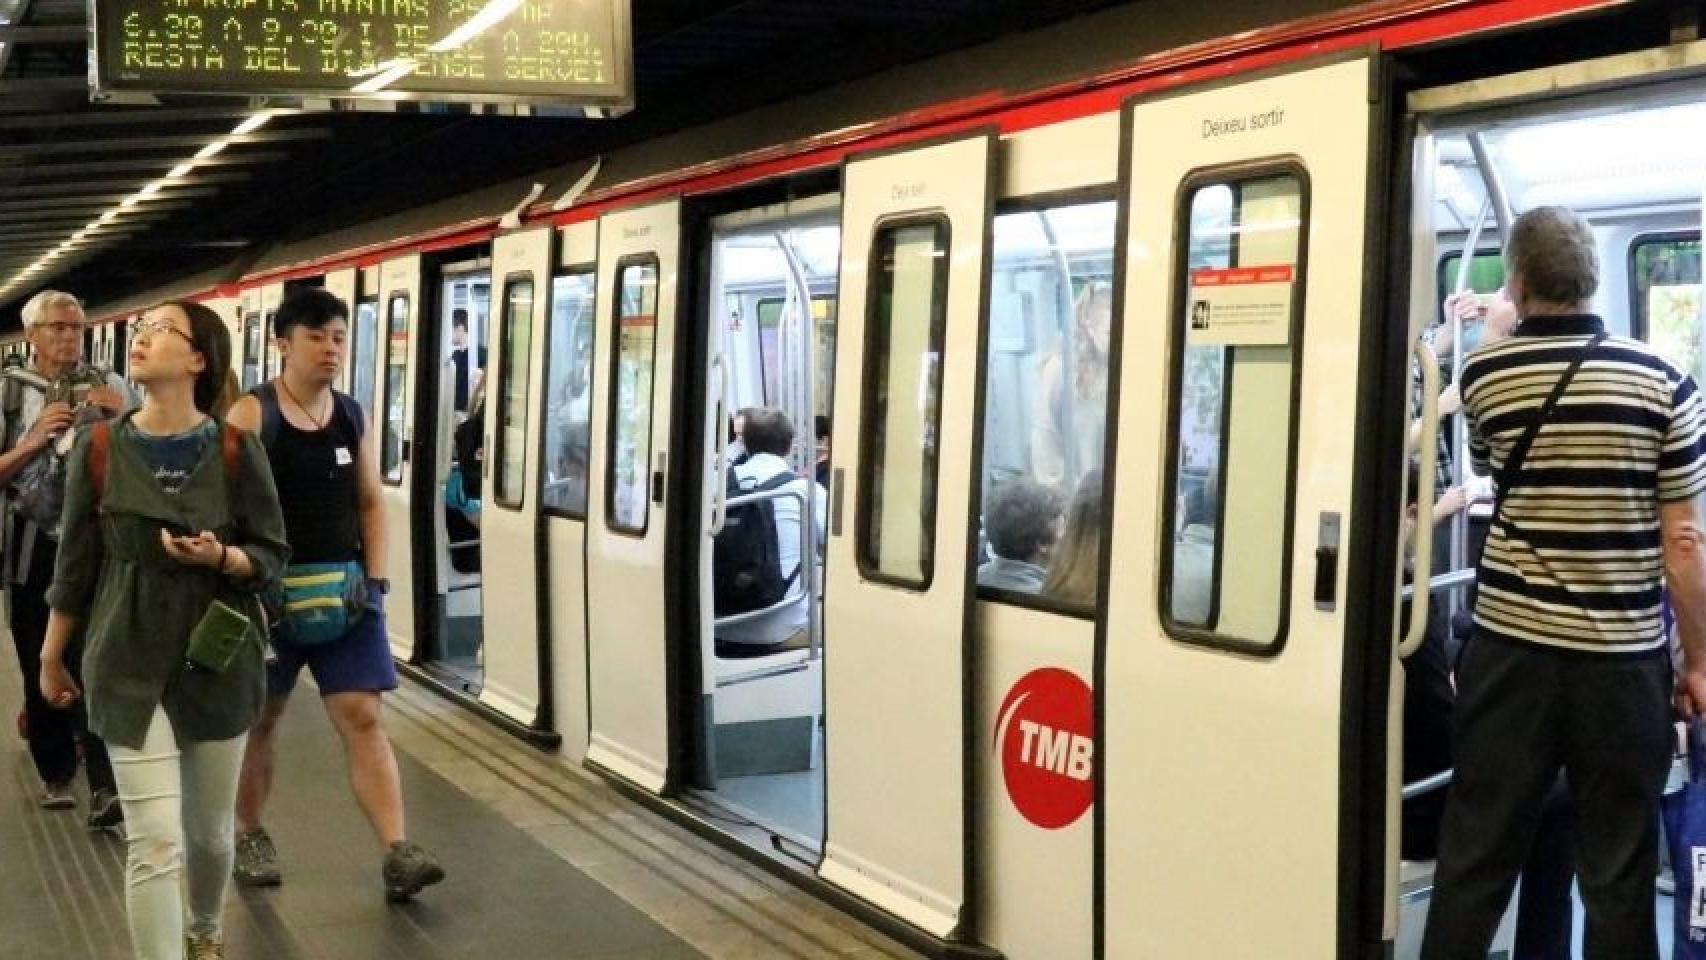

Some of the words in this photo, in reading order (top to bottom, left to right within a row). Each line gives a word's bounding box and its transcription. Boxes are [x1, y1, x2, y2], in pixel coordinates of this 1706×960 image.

[125, 41, 224, 69] RESTA
[243, 45, 301, 72] DEL
[503, 55, 603, 82] SERVEI
[1202, 116, 1247, 139] Deixeu
[1250, 103, 1286, 129] sortir
[1019, 719, 1094, 781] TMB
